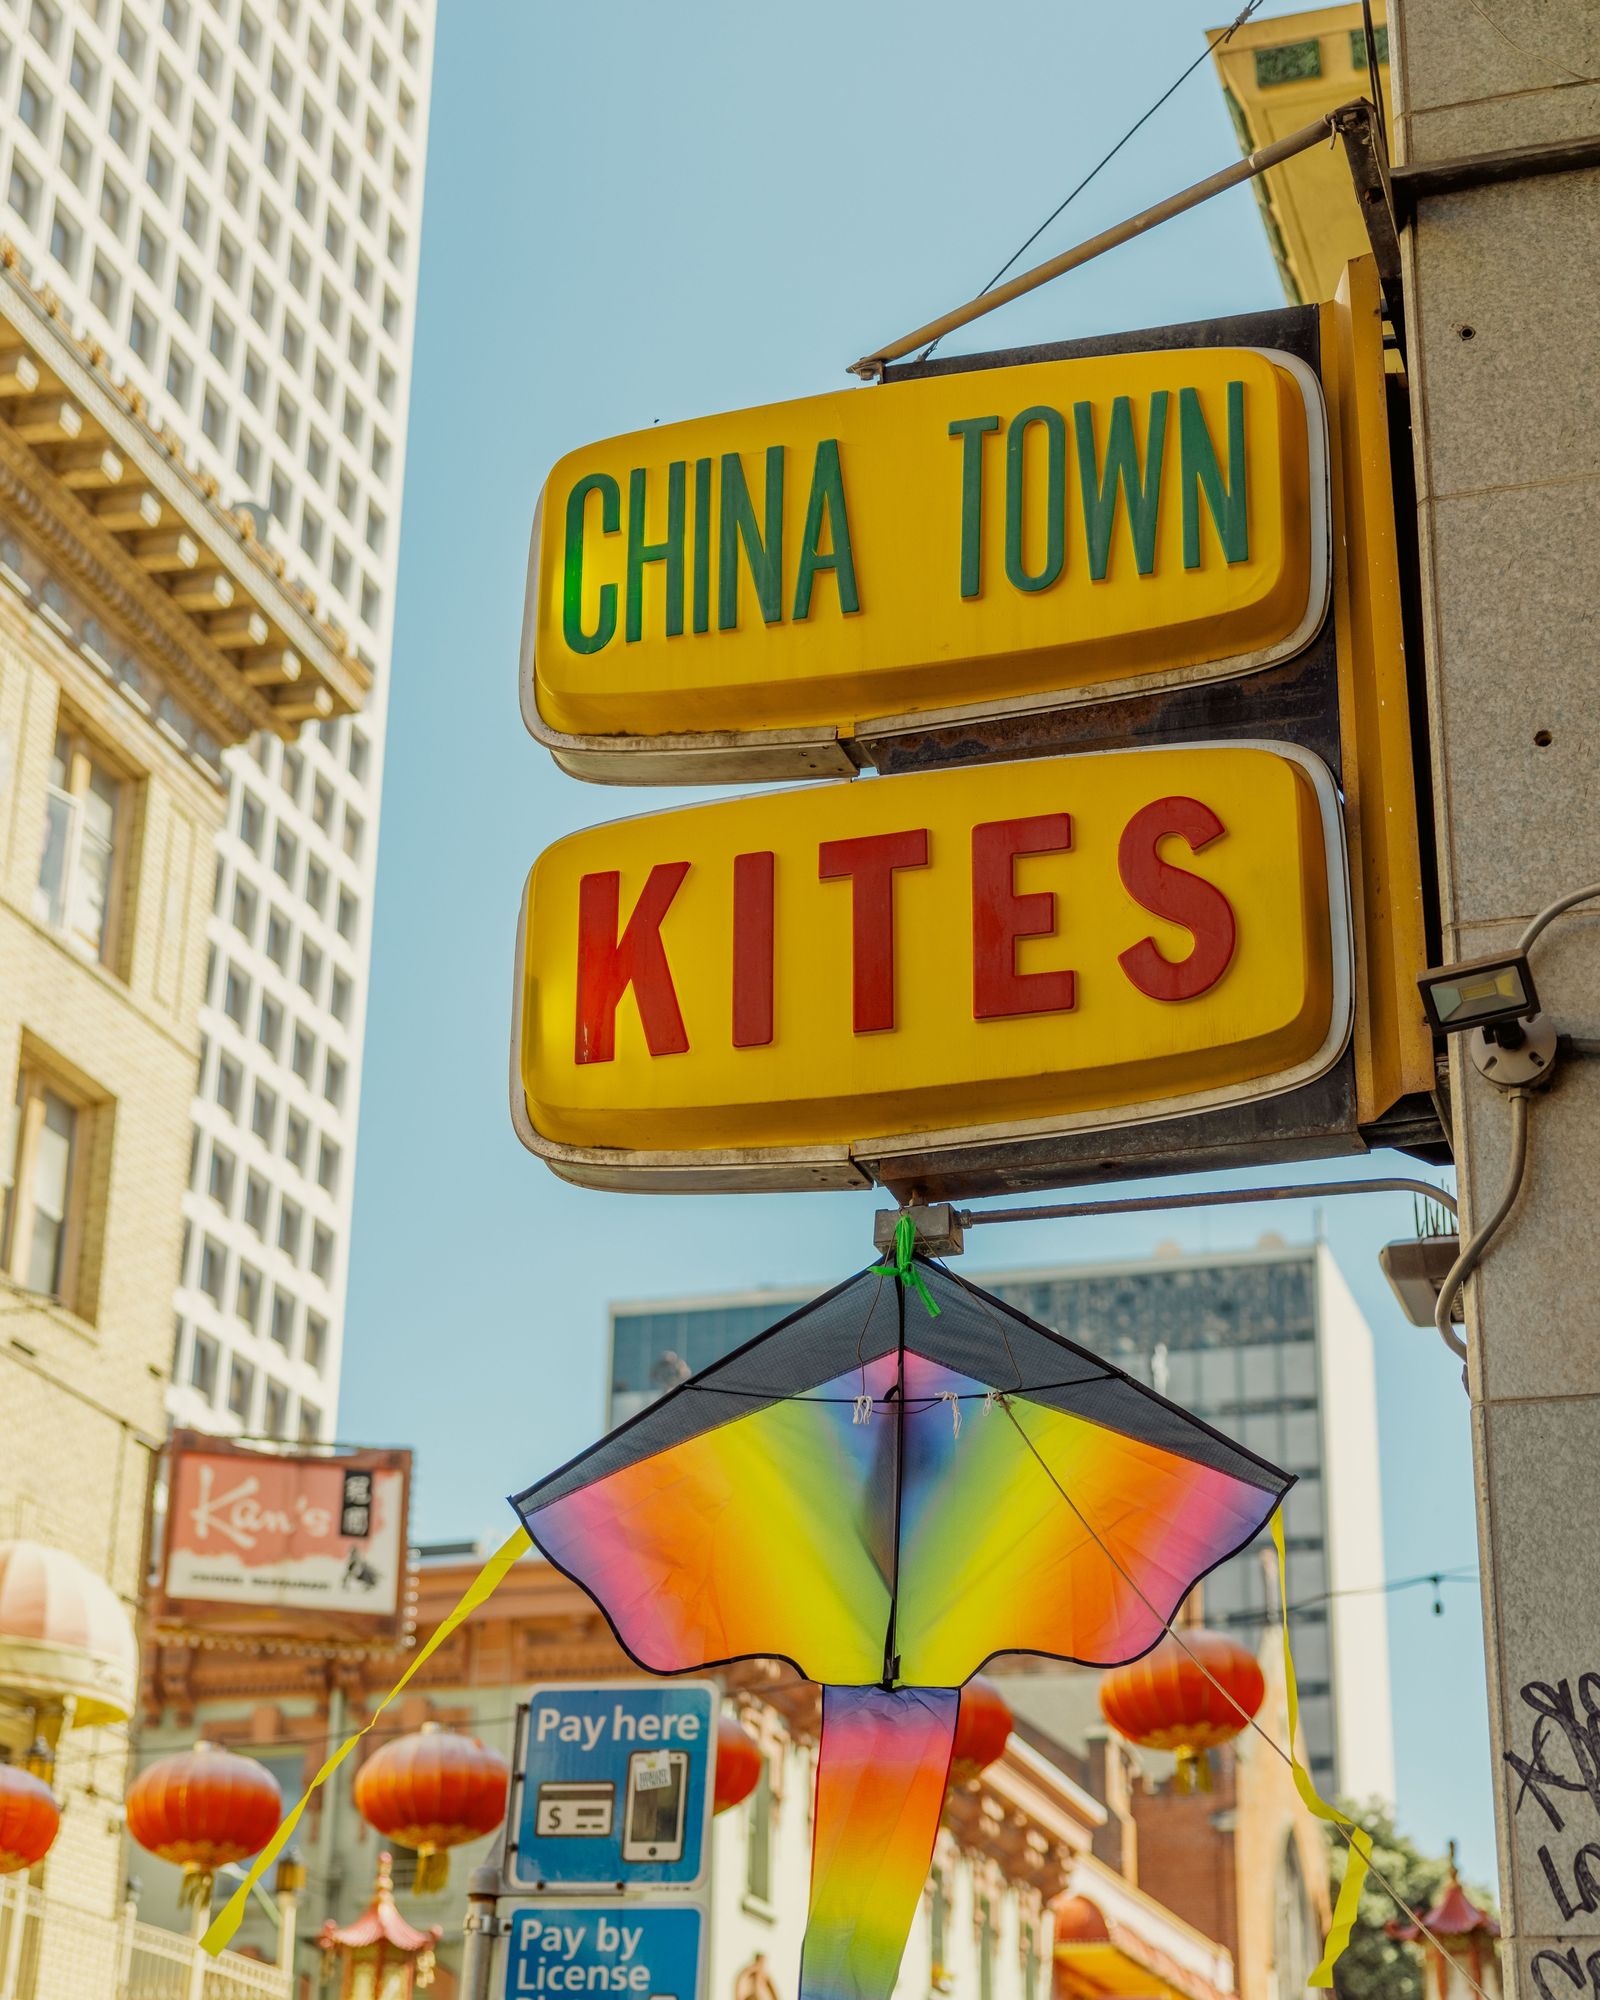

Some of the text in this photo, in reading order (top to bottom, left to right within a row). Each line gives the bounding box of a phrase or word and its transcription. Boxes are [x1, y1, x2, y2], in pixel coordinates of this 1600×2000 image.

[563, 381, 1249, 655] CHINA TOWN
[574, 795, 1237, 1065] KITES
[190, 1464, 333, 1548] Kan's
[537, 1705, 700, 1751] Pay here
[520, 1917, 643, 1962] Pay by
[517, 1957, 650, 1991] License
